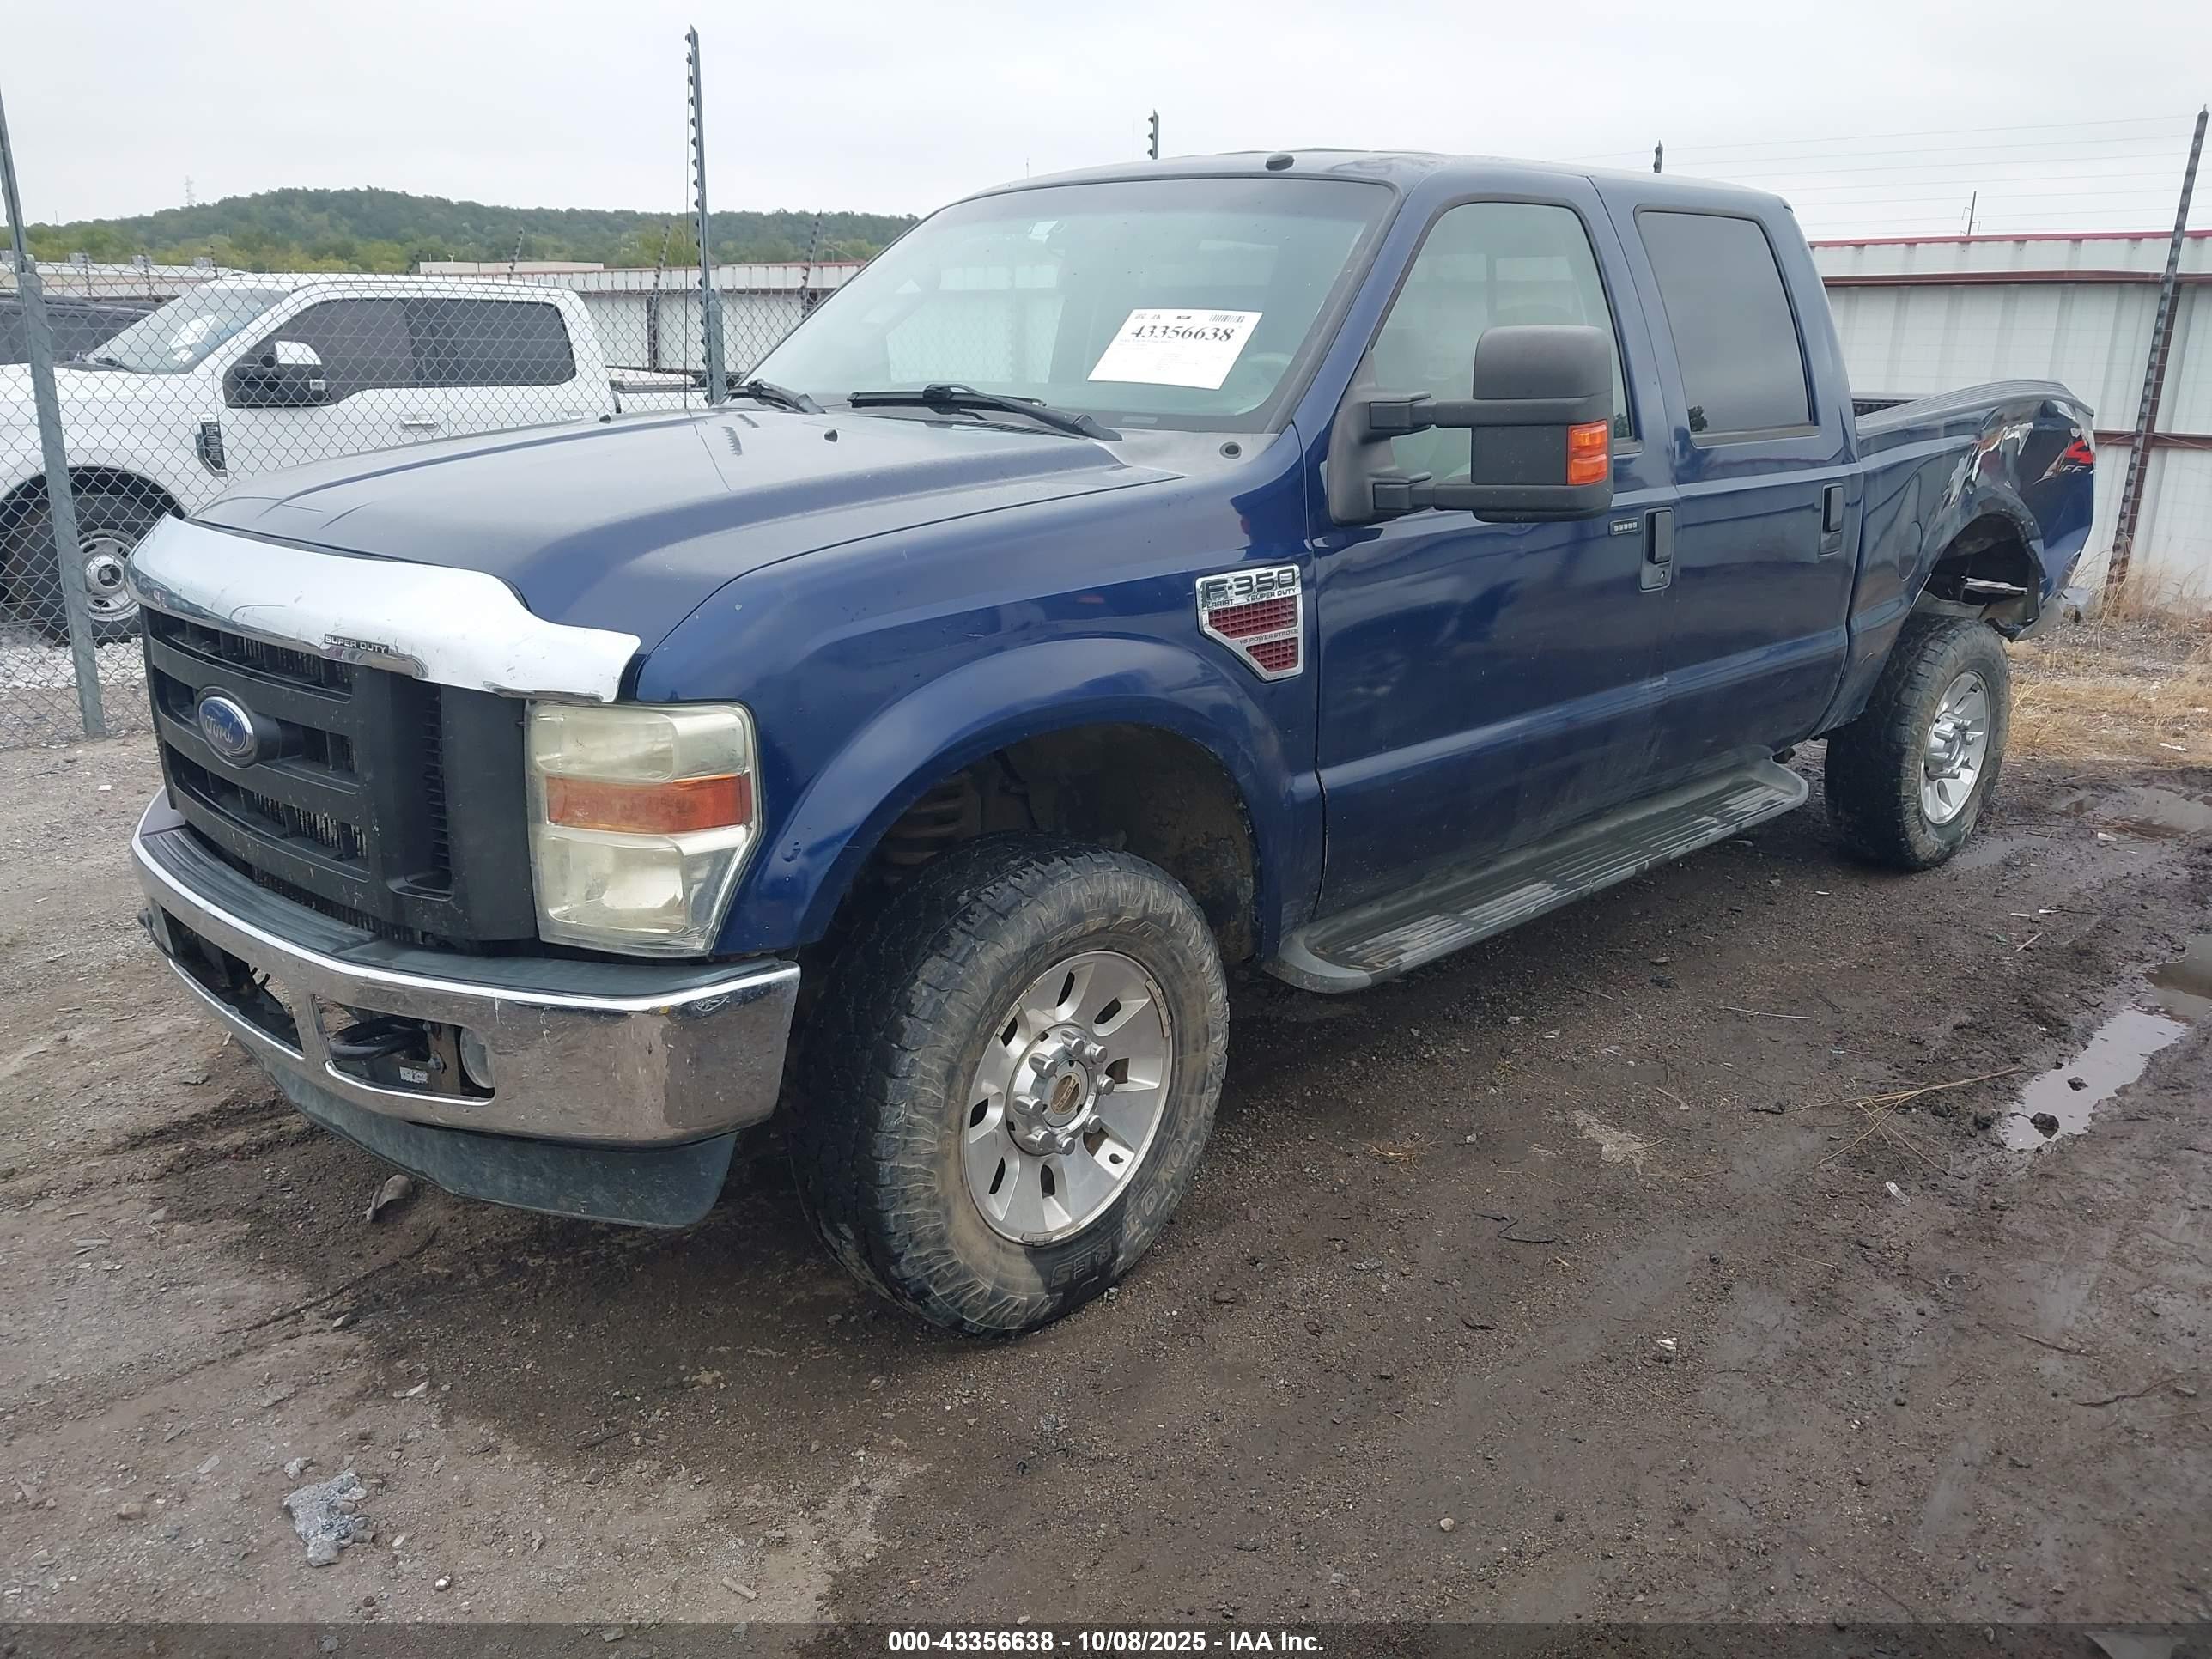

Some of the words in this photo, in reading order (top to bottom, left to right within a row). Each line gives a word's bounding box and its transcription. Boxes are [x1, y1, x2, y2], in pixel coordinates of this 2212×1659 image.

[1131, 325, 1235, 342] 43356638
[1206, 568, 1296, 599] F-350
[1250, 591, 1276, 601] SUPER
[1277, 587, 1297, 597] DUTY
[1206, 599, 1234, 609] LARIAT
[325, 635, 356, 648] SUPER
[360, 640, 386, 653] DUTY
[1249, 634, 1273, 642] POWER
